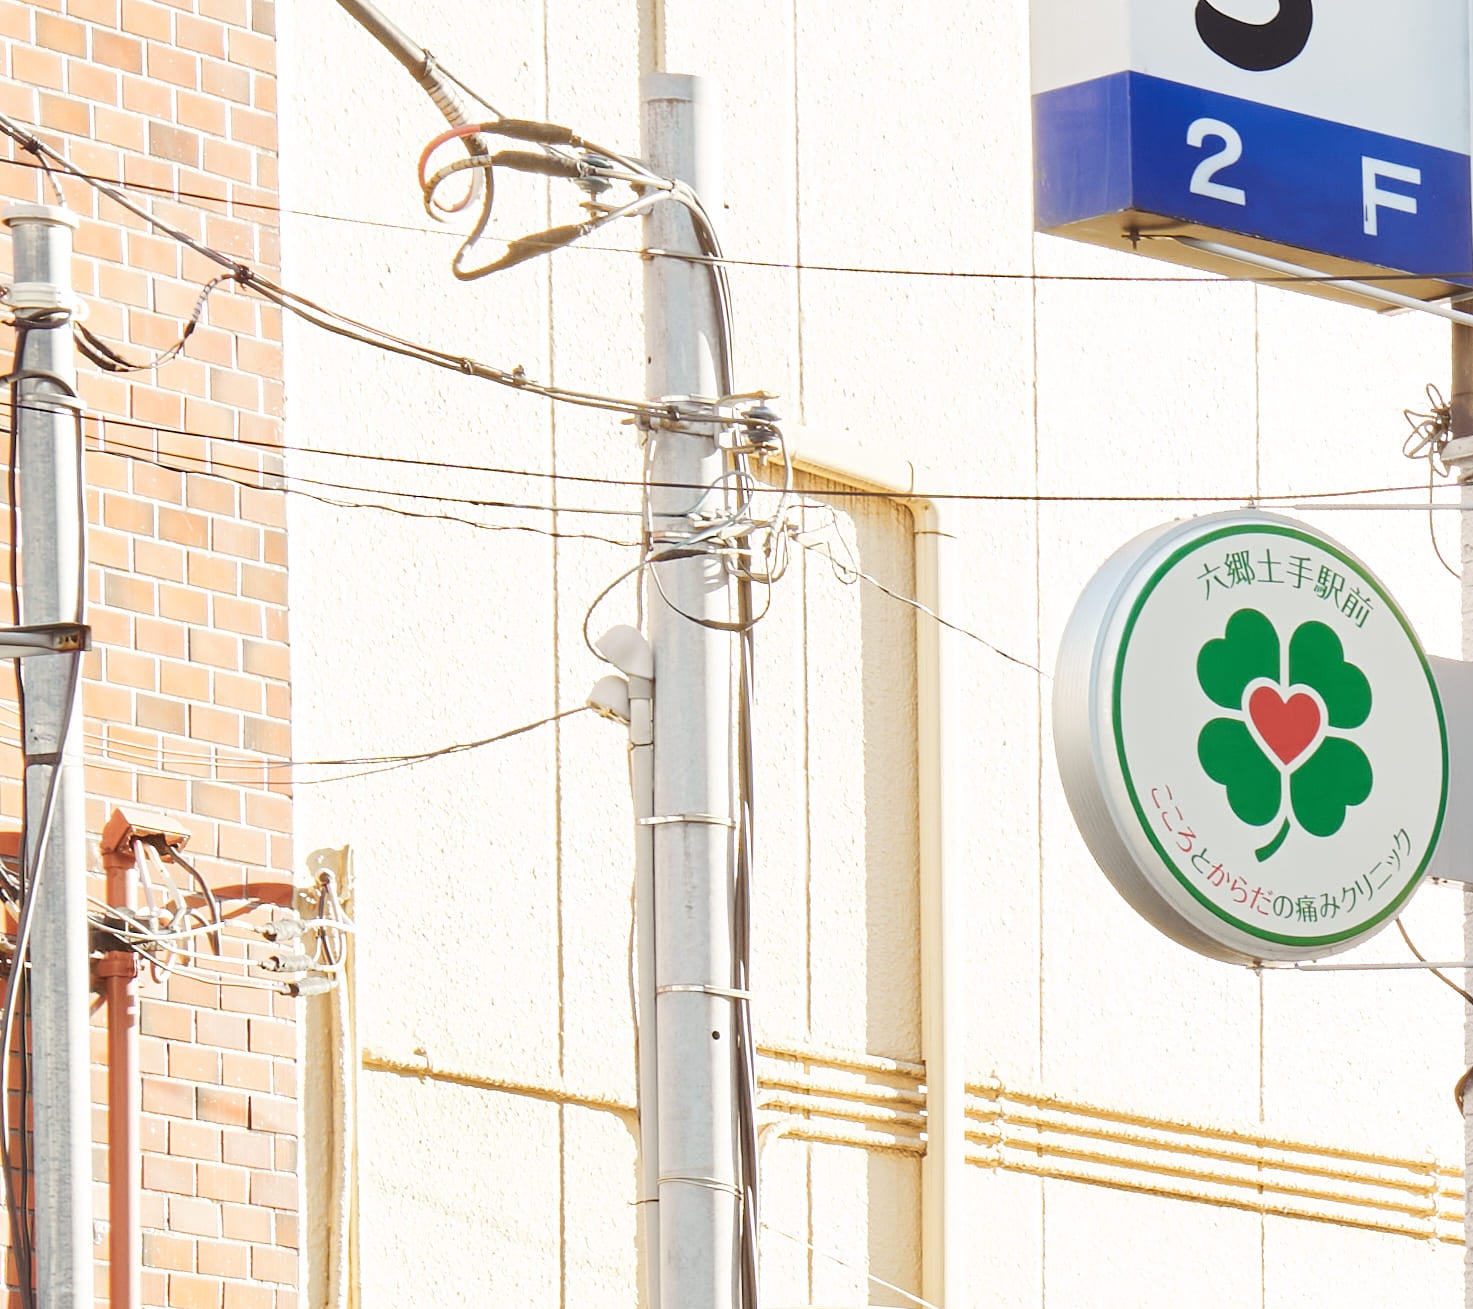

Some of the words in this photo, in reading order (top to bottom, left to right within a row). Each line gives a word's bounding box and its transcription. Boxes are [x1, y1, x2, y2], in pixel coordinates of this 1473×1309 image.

[1197, 549, 1374, 628] 六郷土手駅前
[1151, 784, 1412, 923] こころとからだの痛みクリニック
